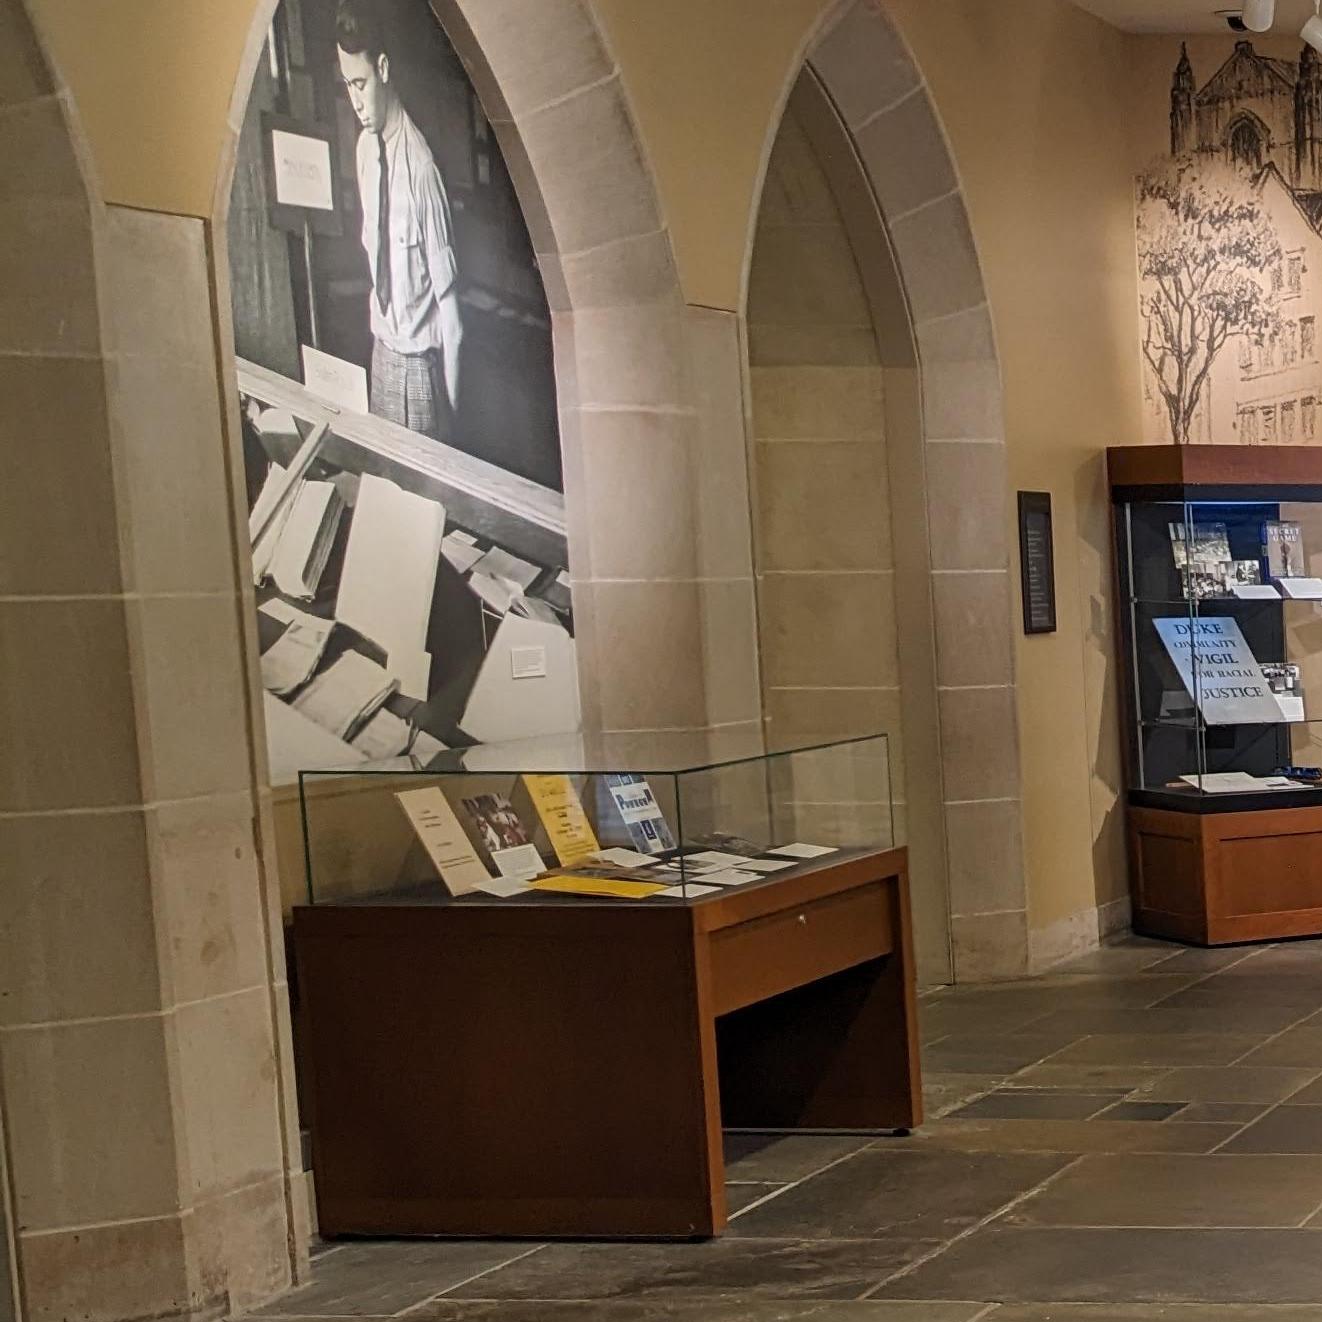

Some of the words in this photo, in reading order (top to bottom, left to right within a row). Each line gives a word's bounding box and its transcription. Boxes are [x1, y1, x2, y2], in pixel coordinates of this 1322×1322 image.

[1174, 622, 1223, 635] DUKE
[1191, 653, 1239, 664] VIGIL
[1202, 686, 1264, 699] JUSTICE
